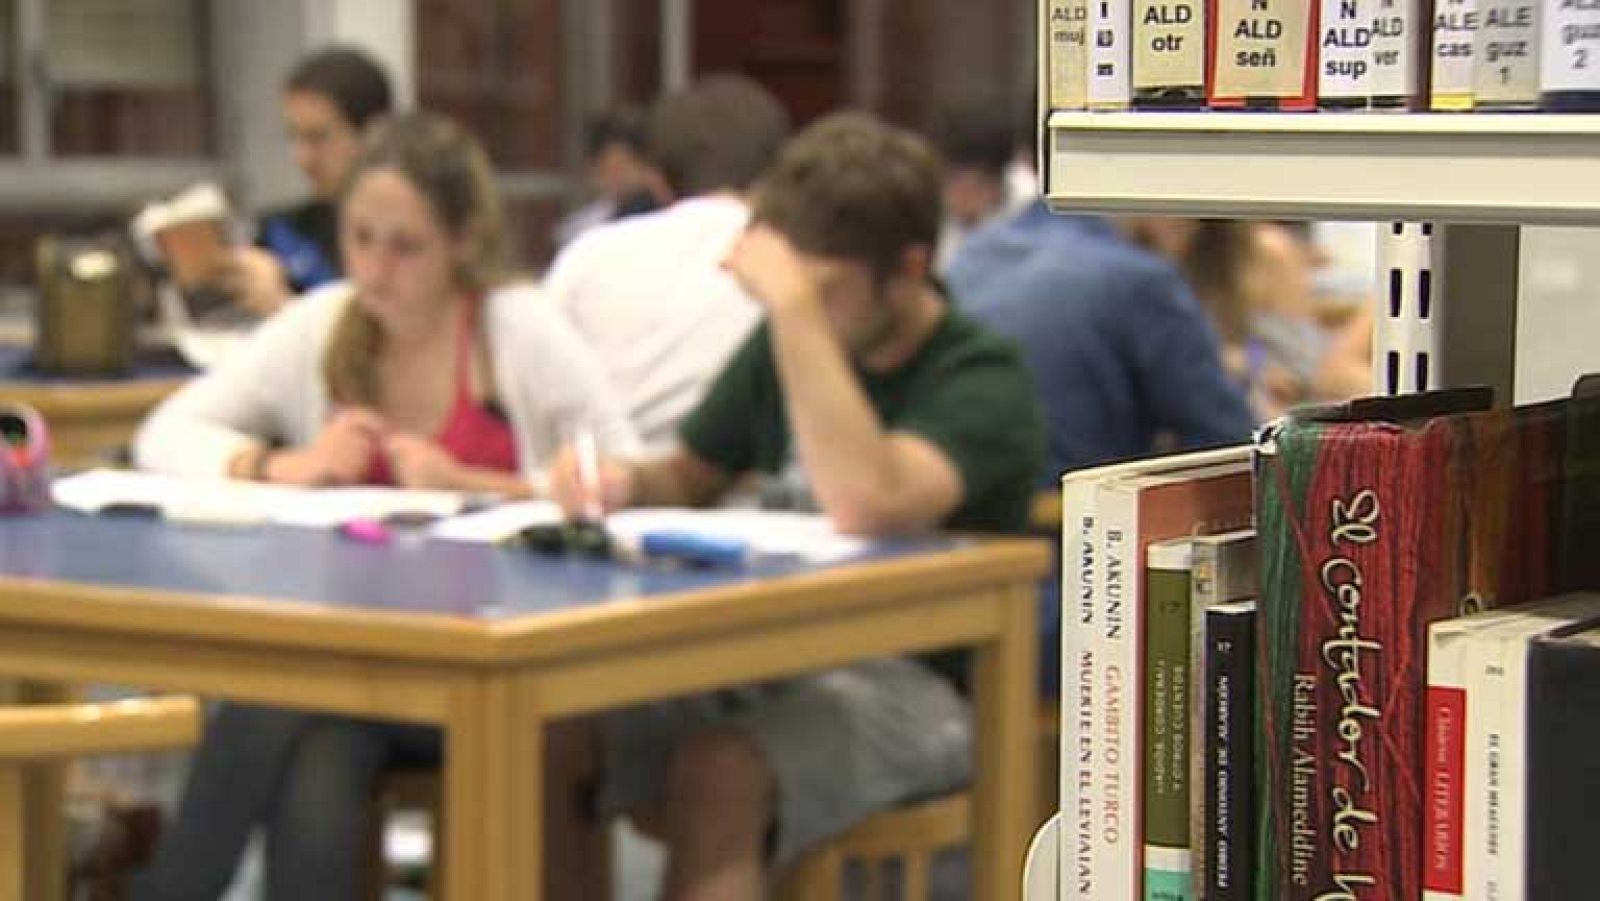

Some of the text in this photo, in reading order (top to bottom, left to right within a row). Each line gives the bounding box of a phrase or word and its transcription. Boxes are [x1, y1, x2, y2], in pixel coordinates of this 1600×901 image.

[1051, 5, 1087, 22] ALD
[1143, 4, 1192, 25] ALD
[1340, 0, 1356, 19] N
[1486, 7, 1532, 28] ALE
[1233, 19, 1283, 40] ALD
[1371, 17, 1403, 37] ALD
[1433, 12, 1480, 31] ALE
[1151, 34, 1184, 52] otr
[1323, 28, 1370, 48] ALD
[1235, 48, 1276, 68] señ
[1437, 42, 1472, 57] cas
[1486, 41, 1528, 62] guz
[1572, 49, 1588, 69] 2
[1324, 60, 1367, 80] sup
[1499, 65, 1510, 85] 1
[1081, 541, 1095, 625] AKUNIN
[1079, 651, 1094, 729] MUERTE
[1103, 528, 1123, 845] B. AKUNIN GAMBITO TURCO
[1079, 737, 1093, 763] EN
[1079, 770, 1093, 788] EL
[1292, 673, 1317, 886] Rabih Alameddine
[1332, 786, 1379, 854] de
